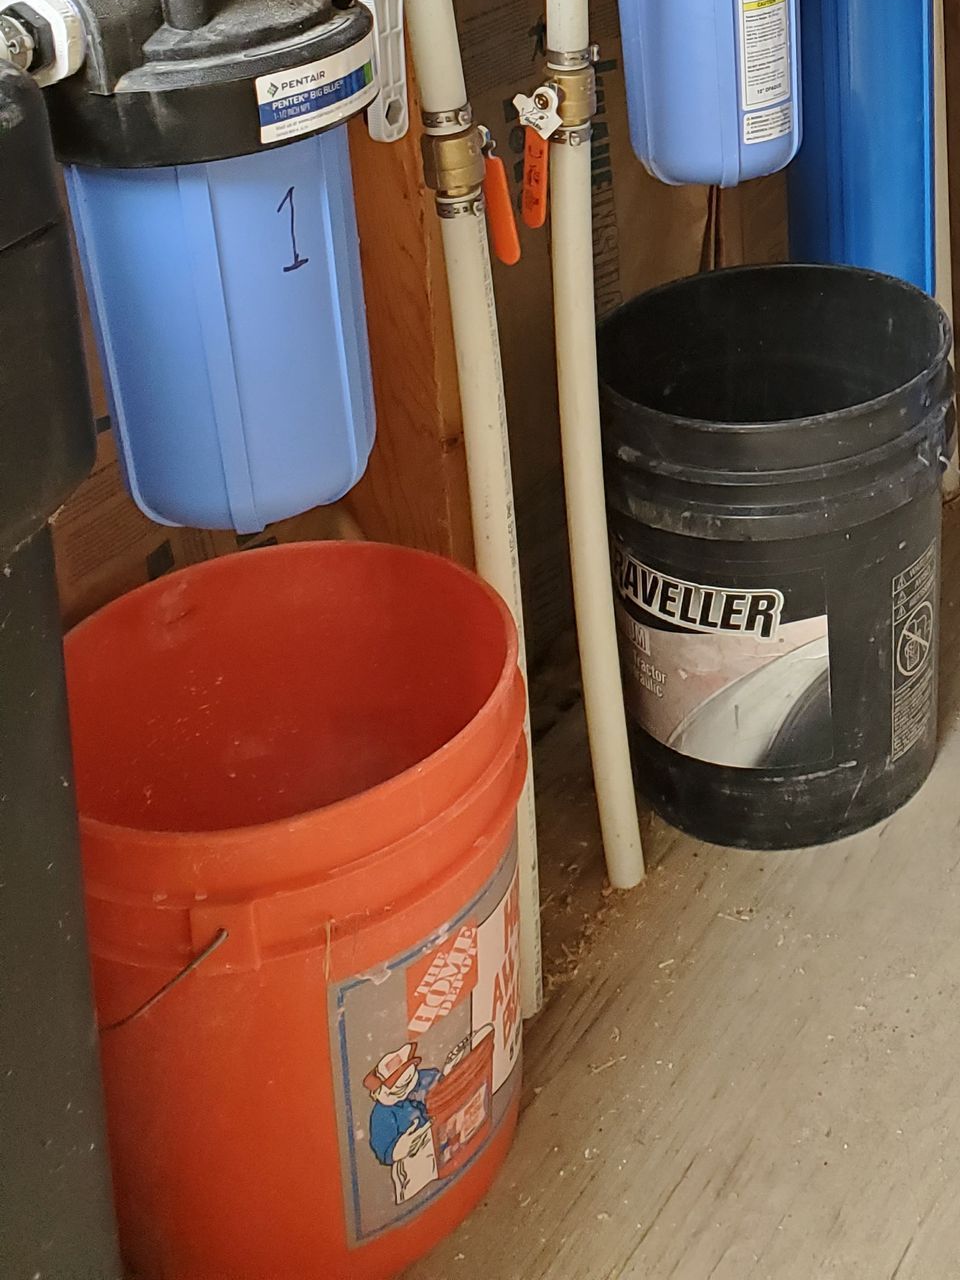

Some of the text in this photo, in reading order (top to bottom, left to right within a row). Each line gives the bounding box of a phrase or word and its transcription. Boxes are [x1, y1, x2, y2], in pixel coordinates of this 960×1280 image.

[281, 70, 326, 91] PENTAIR
[310, 88, 324, 100] BIG
[276, 186, 310, 271] 1
[407, 925, 474, 1033] HOME
[414, 951, 449, 997] THE
[437, 927, 477, 1017] DEPOT
